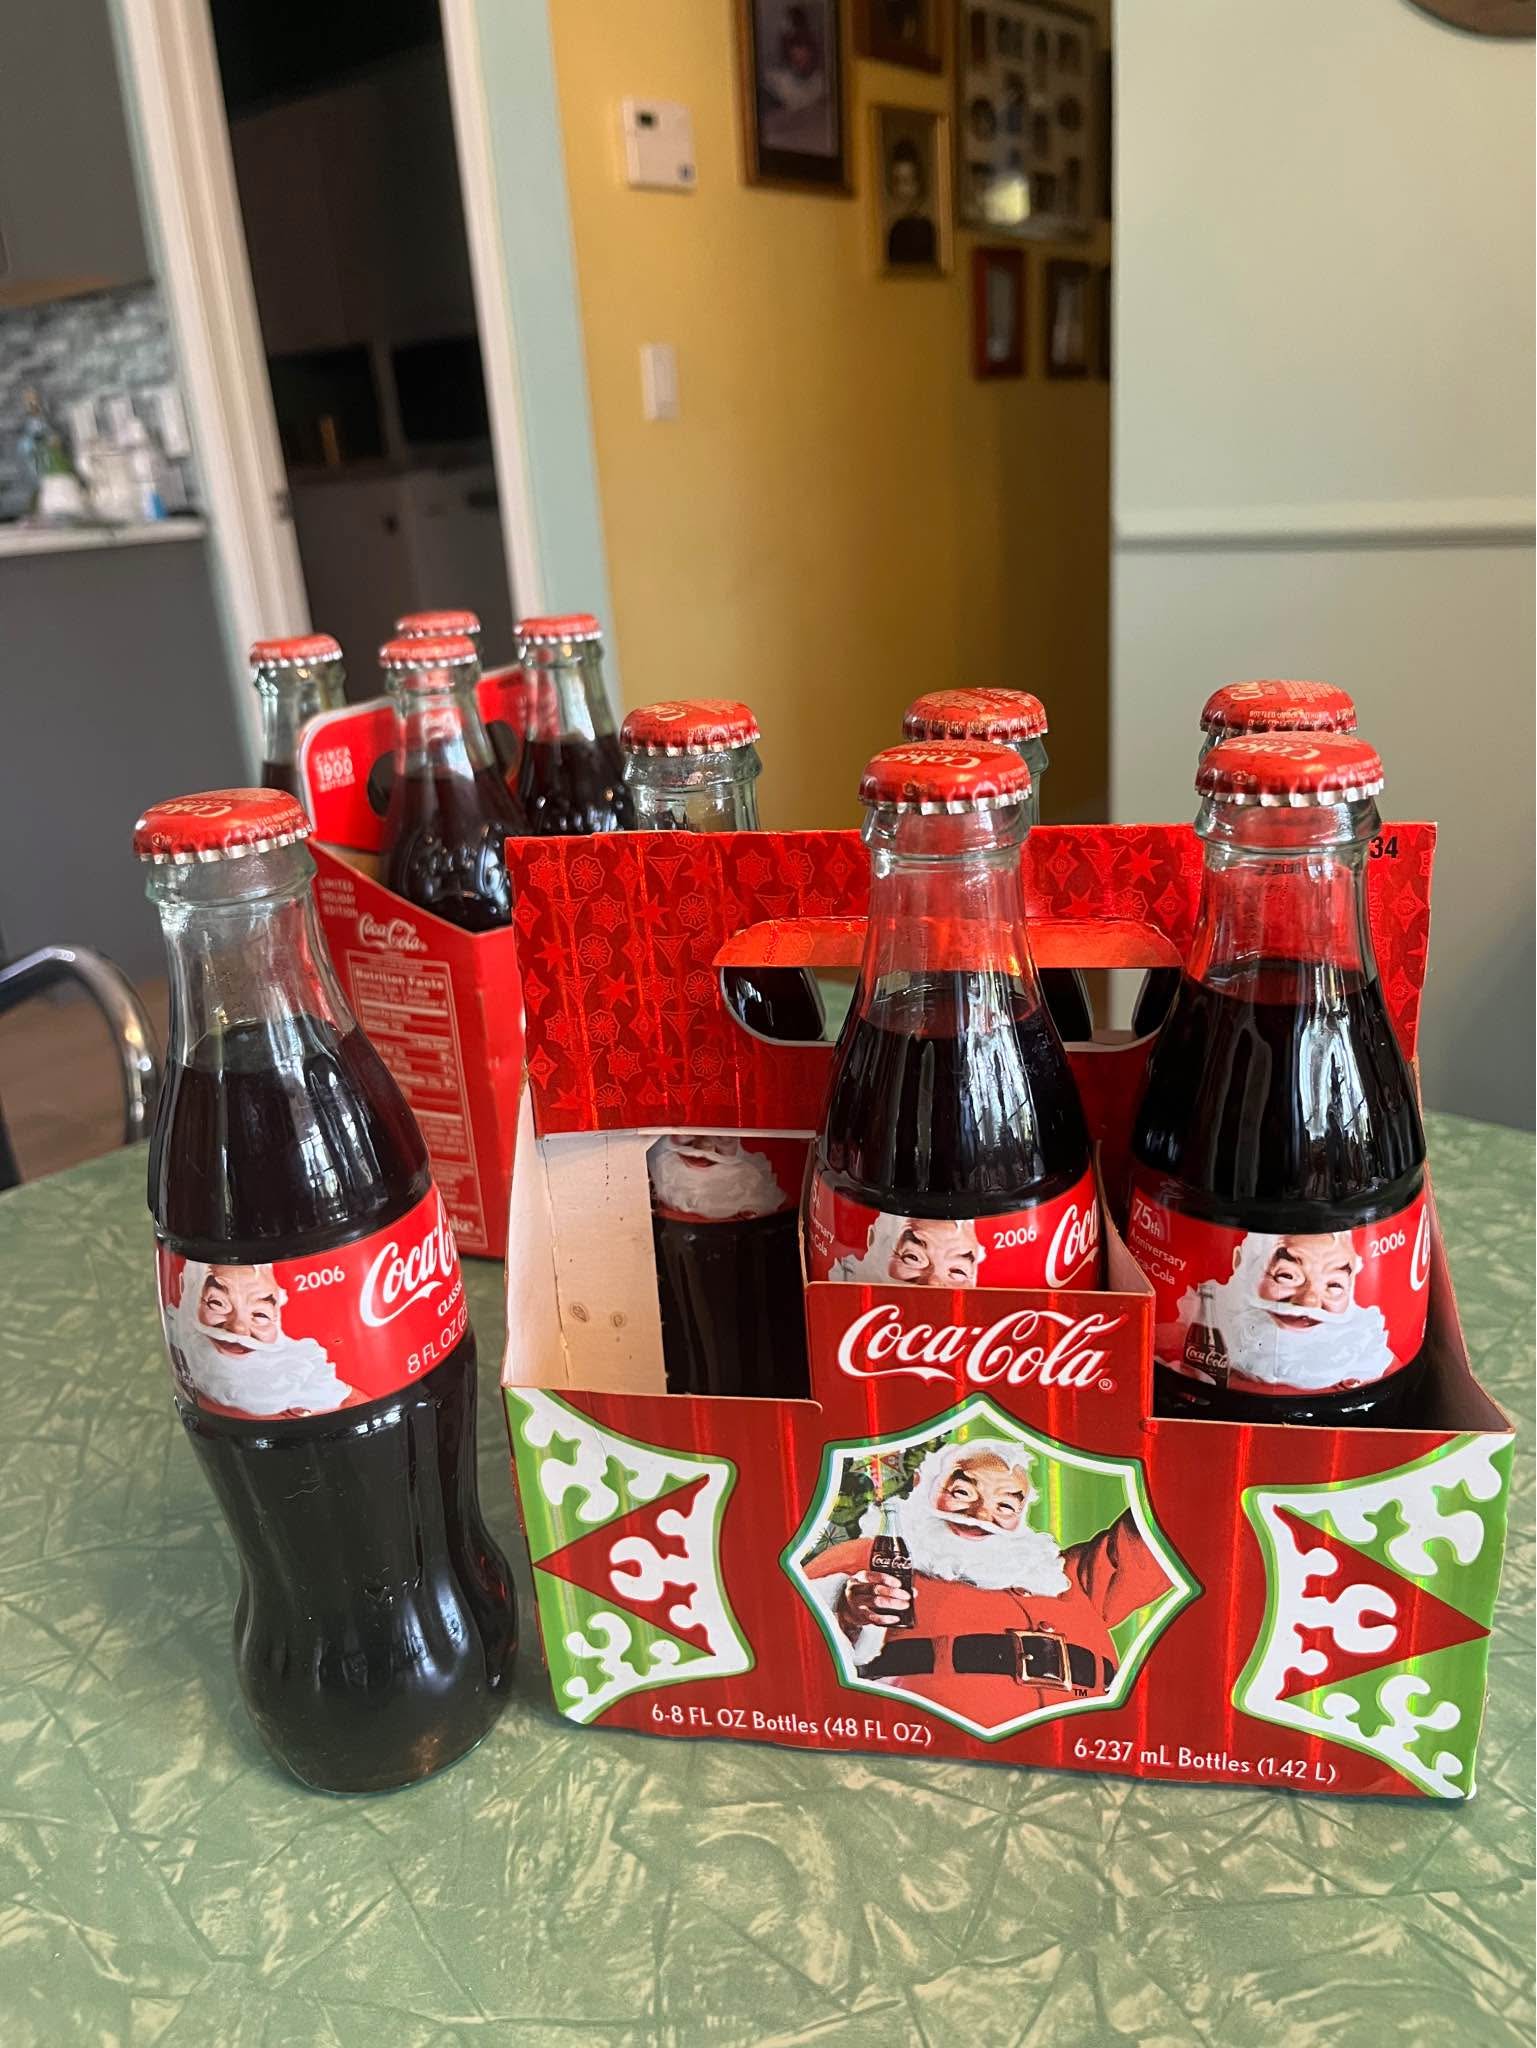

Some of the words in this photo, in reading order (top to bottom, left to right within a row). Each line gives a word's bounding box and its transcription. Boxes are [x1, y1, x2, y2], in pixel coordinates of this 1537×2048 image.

[316, 757, 354, 782] 1900
[879, 753, 982, 769] Coke
[1369, 836, 1399, 858] 34
[319, 878, 355, 892] LIMITED
[322, 904, 359, 918] EDITION
[355, 969, 405, 985] Nutrition
[1133, 1197, 1161, 1238] 75th
[993, 1228, 1037, 1250] 2006
[1369, 1228, 1406, 1259] 2006
[294, 1265, 346, 1292] 2006
[407, 1353, 421, 1375] 8
[422, 1341, 440, 1366] FL
[441, 1318, 459, 1349] OZ
[838, 1304, 1122, 1388] Coca-Cola
[652, 1703, 684, 1724] 6-8
[689, 1706, 713, 1727] FL
[717, 1708, 747, 1729] OZ
[752, 1710, 819, 1735] Bottles
[823, 1716, 858, 1740] (48
[864, 1719, 888, 1740] FL
[893, 1722, 933, 1748] OZ)
[1073, 1737, 1134, 1762] 6-237
[1140, 1747, 1171, 1766] mL
[1178, 1746, 1251, 1774] Bottles
[1256, 1757, 1308, 1779] (1.42
[1314, 1762, 1337, 1785] L)
